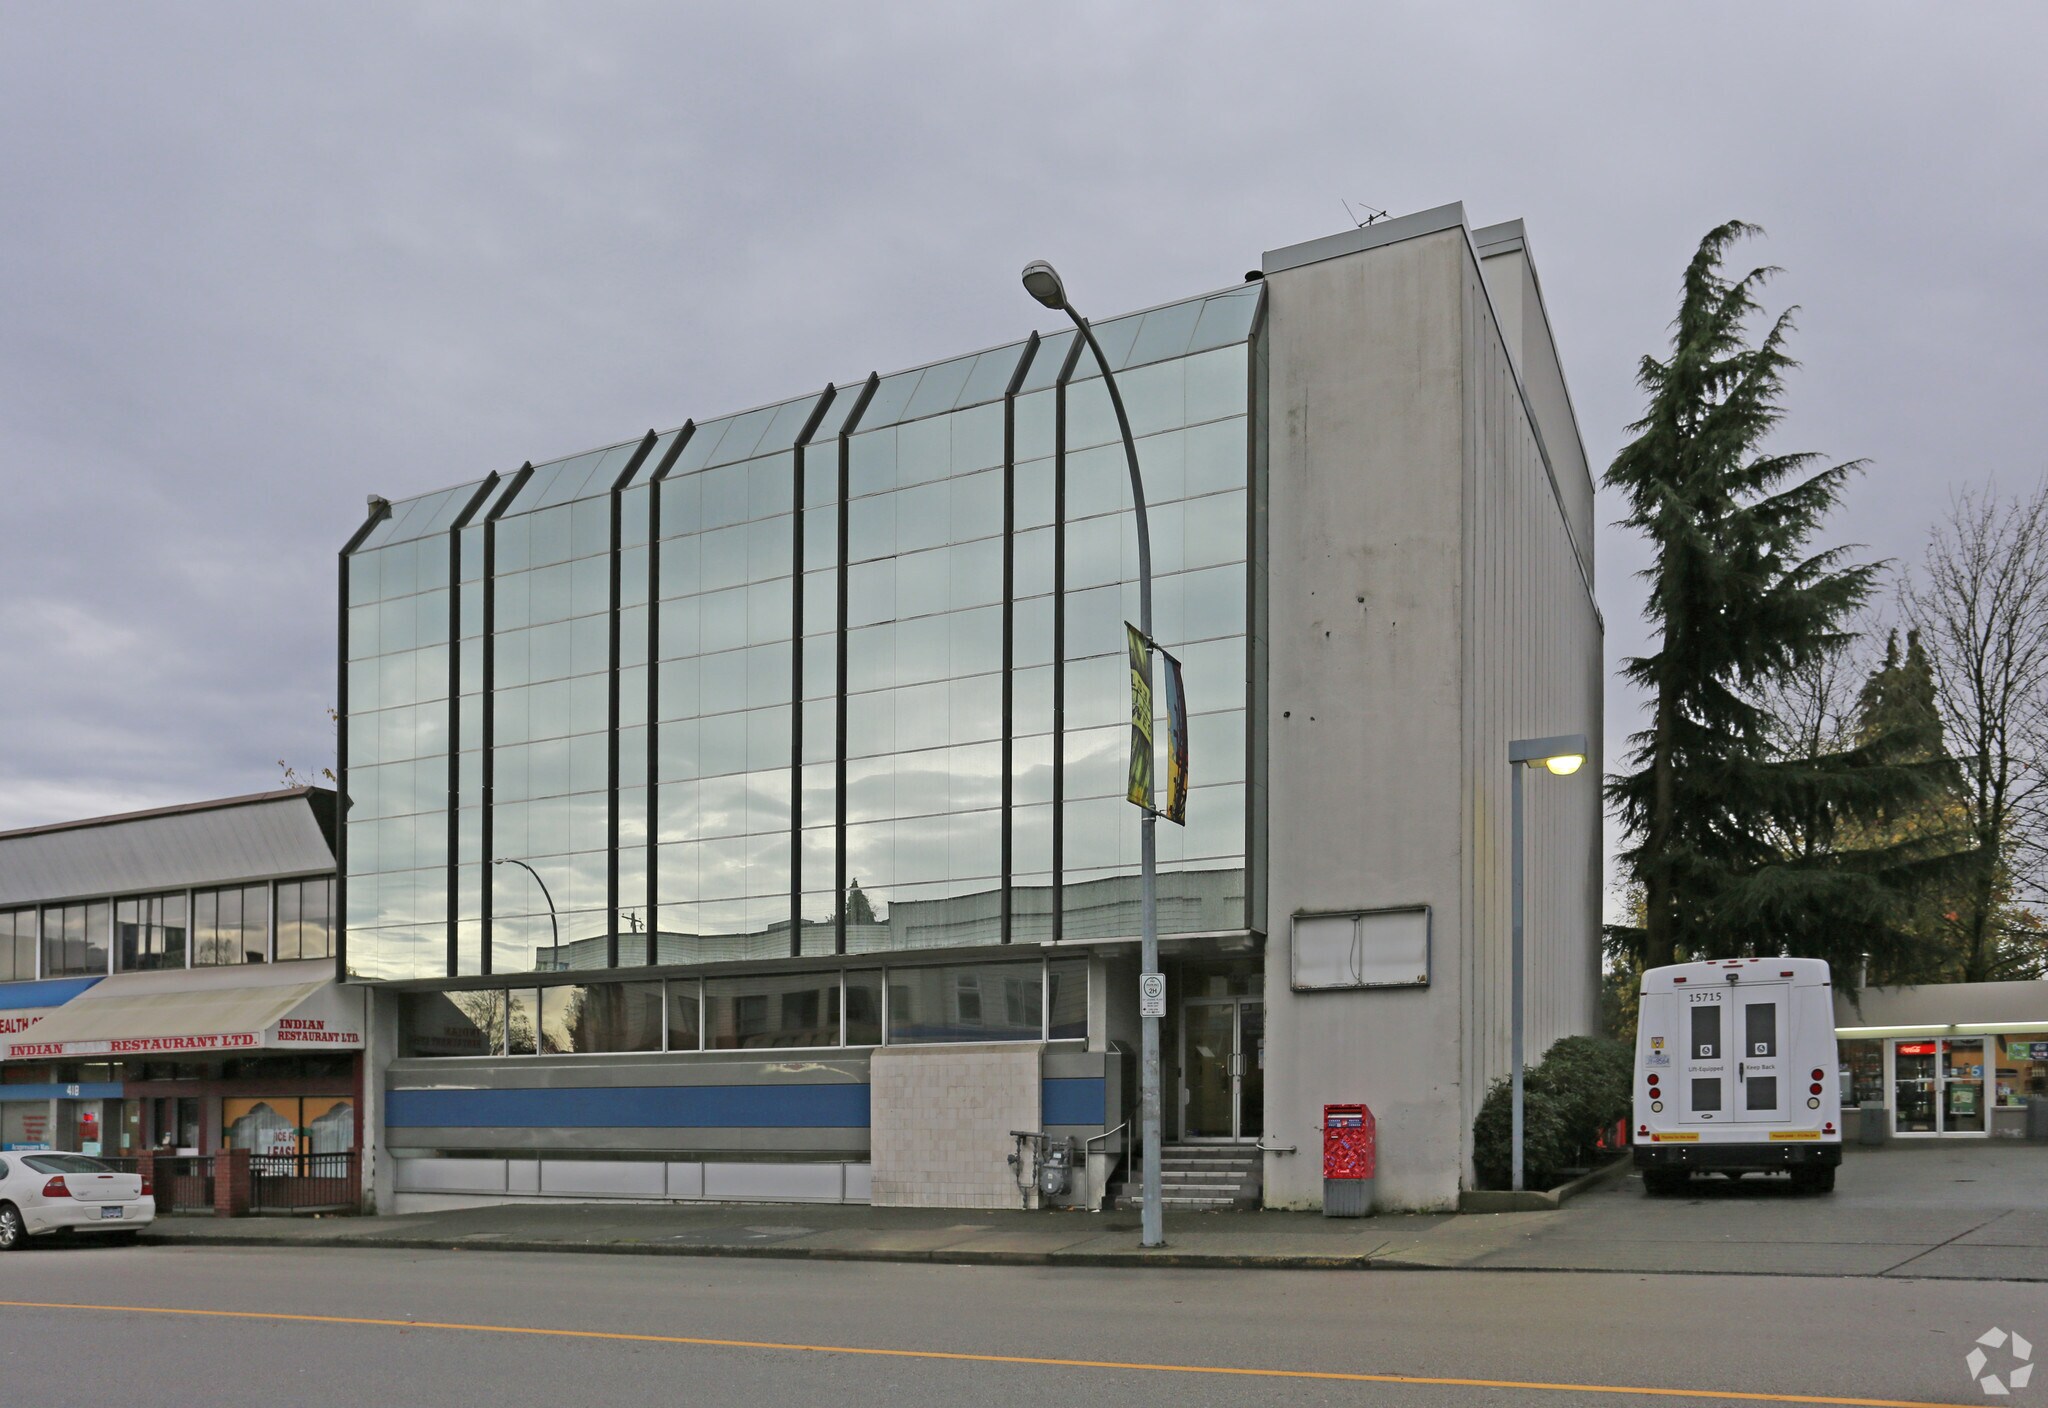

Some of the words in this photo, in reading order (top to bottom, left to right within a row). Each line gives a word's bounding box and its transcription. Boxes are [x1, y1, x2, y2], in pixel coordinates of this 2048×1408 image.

[1689, 992, 1722, 1003] 15715
[279, 1019, 325, 1030] INDIAN
[277, 1031, 340, 1042] RESTAURANT
[341, 1033, 360, 1043] LTD.
[10, 1042, 63, 1056] INDIAN
[110, 1036, 218, 1051] RESTAURANT
[221, 1034, 258, 1047] LTD.
[66, 1085, 79, 1096] 418
